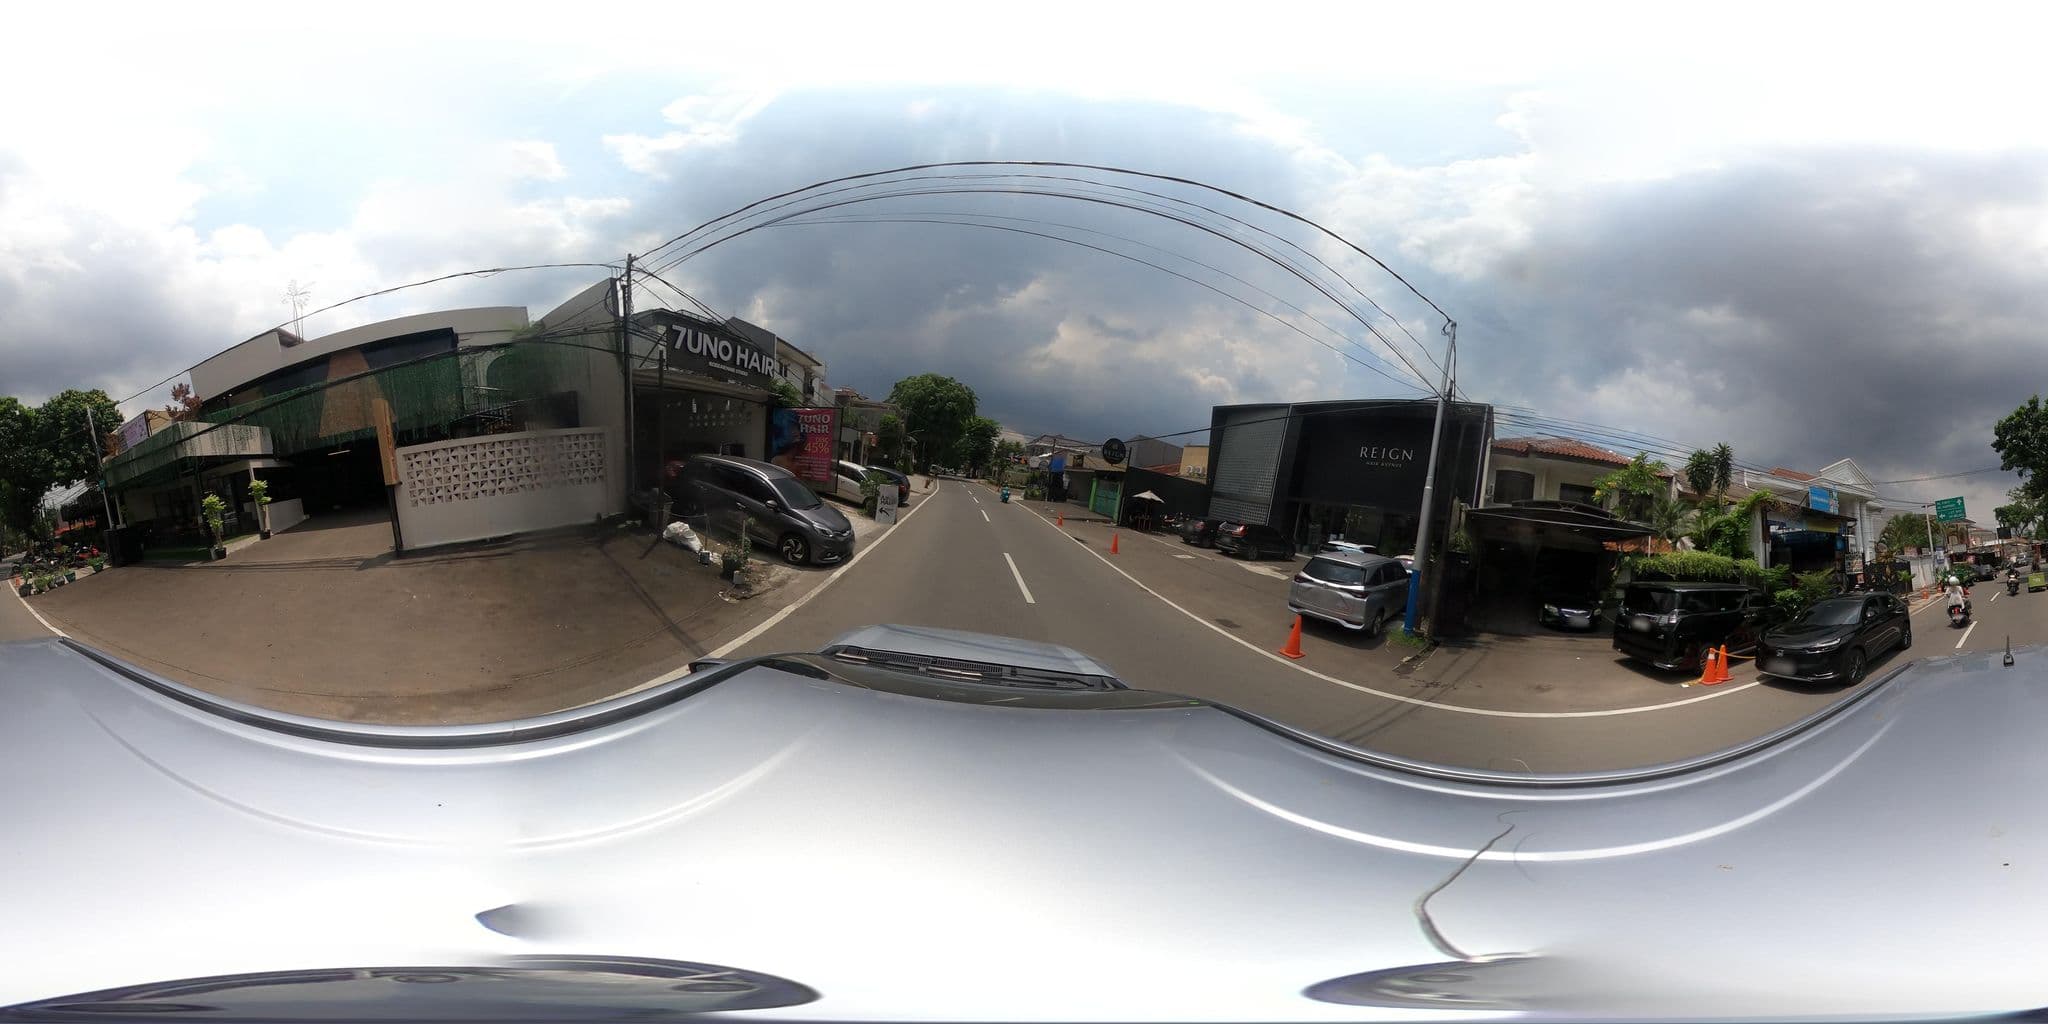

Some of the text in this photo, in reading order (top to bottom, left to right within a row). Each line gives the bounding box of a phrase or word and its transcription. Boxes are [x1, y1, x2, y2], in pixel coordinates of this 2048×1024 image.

[672, 324, 732, 361] 7UNO
[736, 345, 774, 378] HAIR
[798, 414, 831, 424] 7UNO
[800, 424, 830, 434] HAIR
[804, 442, 830, 455] 45%
[1360, 446, 1414, 461] REIGN
